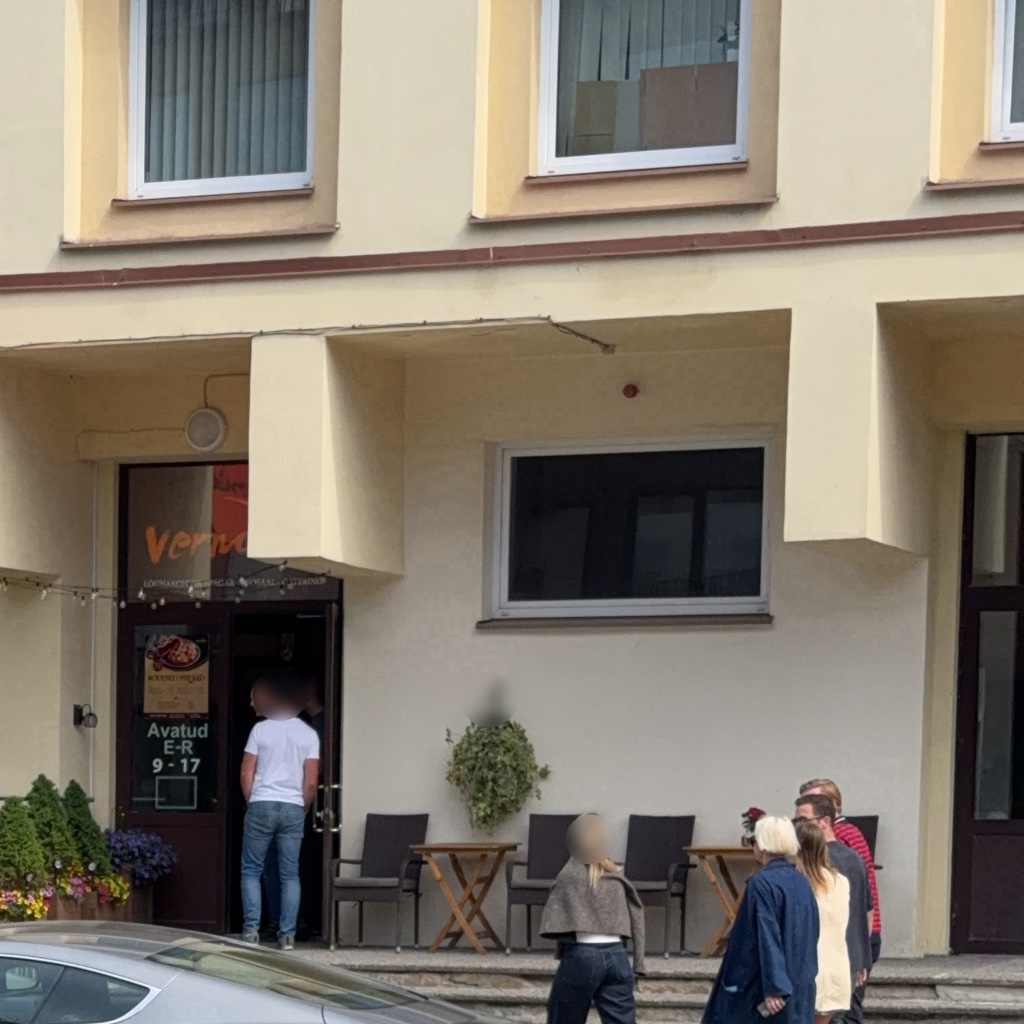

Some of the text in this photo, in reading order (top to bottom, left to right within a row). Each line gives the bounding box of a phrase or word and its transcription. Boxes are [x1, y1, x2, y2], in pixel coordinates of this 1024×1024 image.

[147, 722, 208, 738] Avatud
[163, 740, 193, 755] E-R
[152, 758, 163, 773] 9
[181, 758, 200, 773] 17
